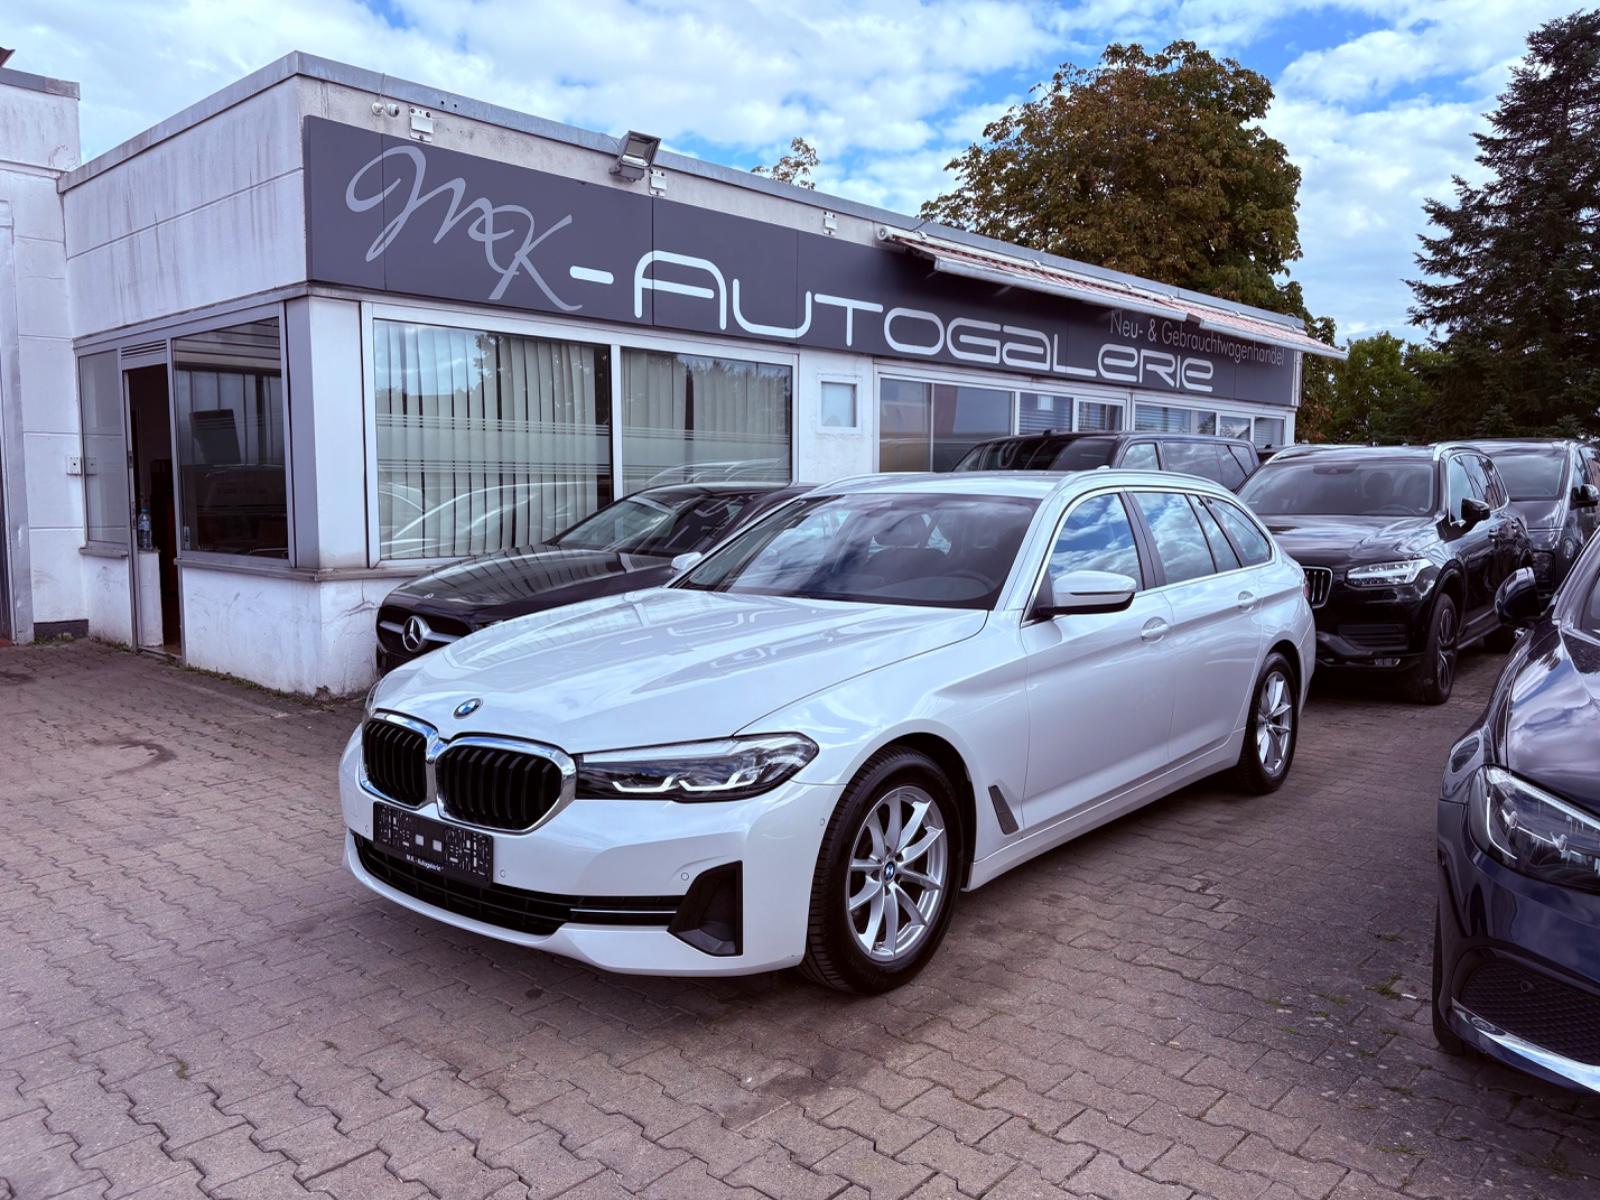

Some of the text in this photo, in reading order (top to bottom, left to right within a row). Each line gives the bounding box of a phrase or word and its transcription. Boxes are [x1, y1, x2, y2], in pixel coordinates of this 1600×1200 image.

[1109, 308, 1285, 367] Neu- & Gebrauchtwagenhandel
